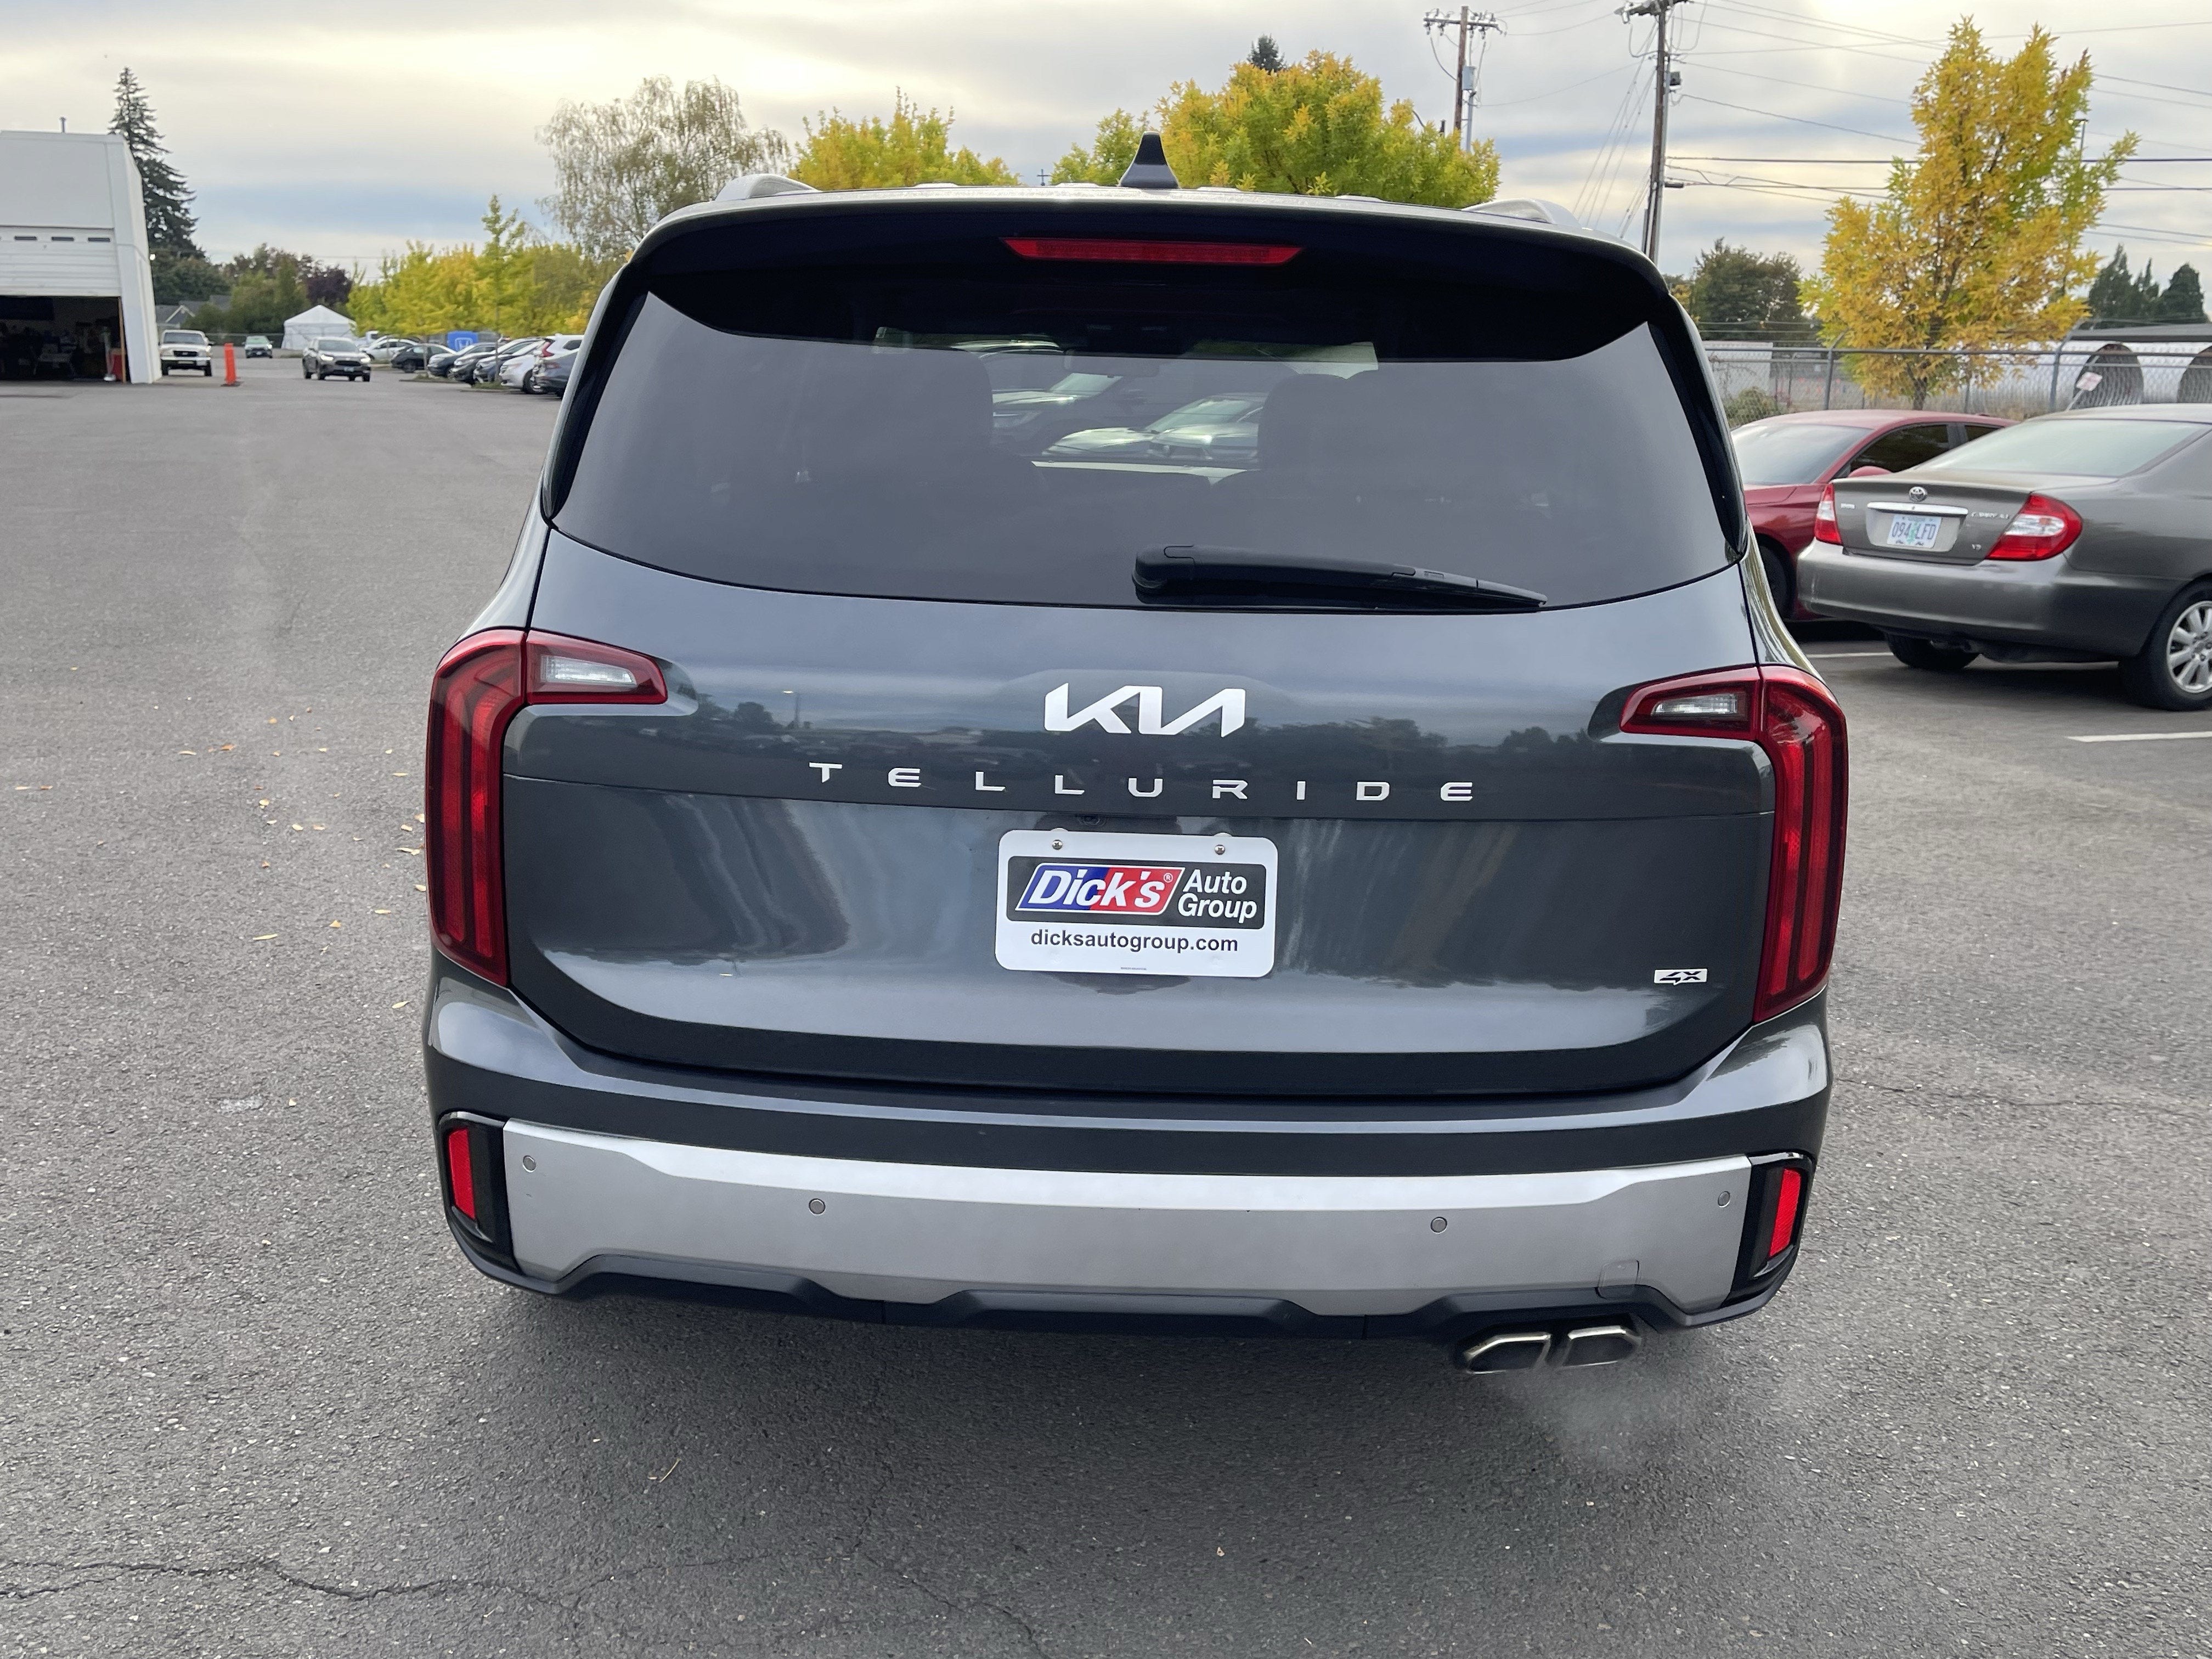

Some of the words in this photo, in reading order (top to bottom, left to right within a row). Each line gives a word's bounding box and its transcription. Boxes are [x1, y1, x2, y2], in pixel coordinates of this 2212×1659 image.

[1892, 522, 1912, 537] 094
[1044, 682, 1246, 737] KIA
[809, 761, 1474, 802] TELLURIDE
[1183, 869, 1247, 895] Auto
[1177, 893, 1257, 923] Group
[1031, 929, 1238, 953] dicksautogroup.com
